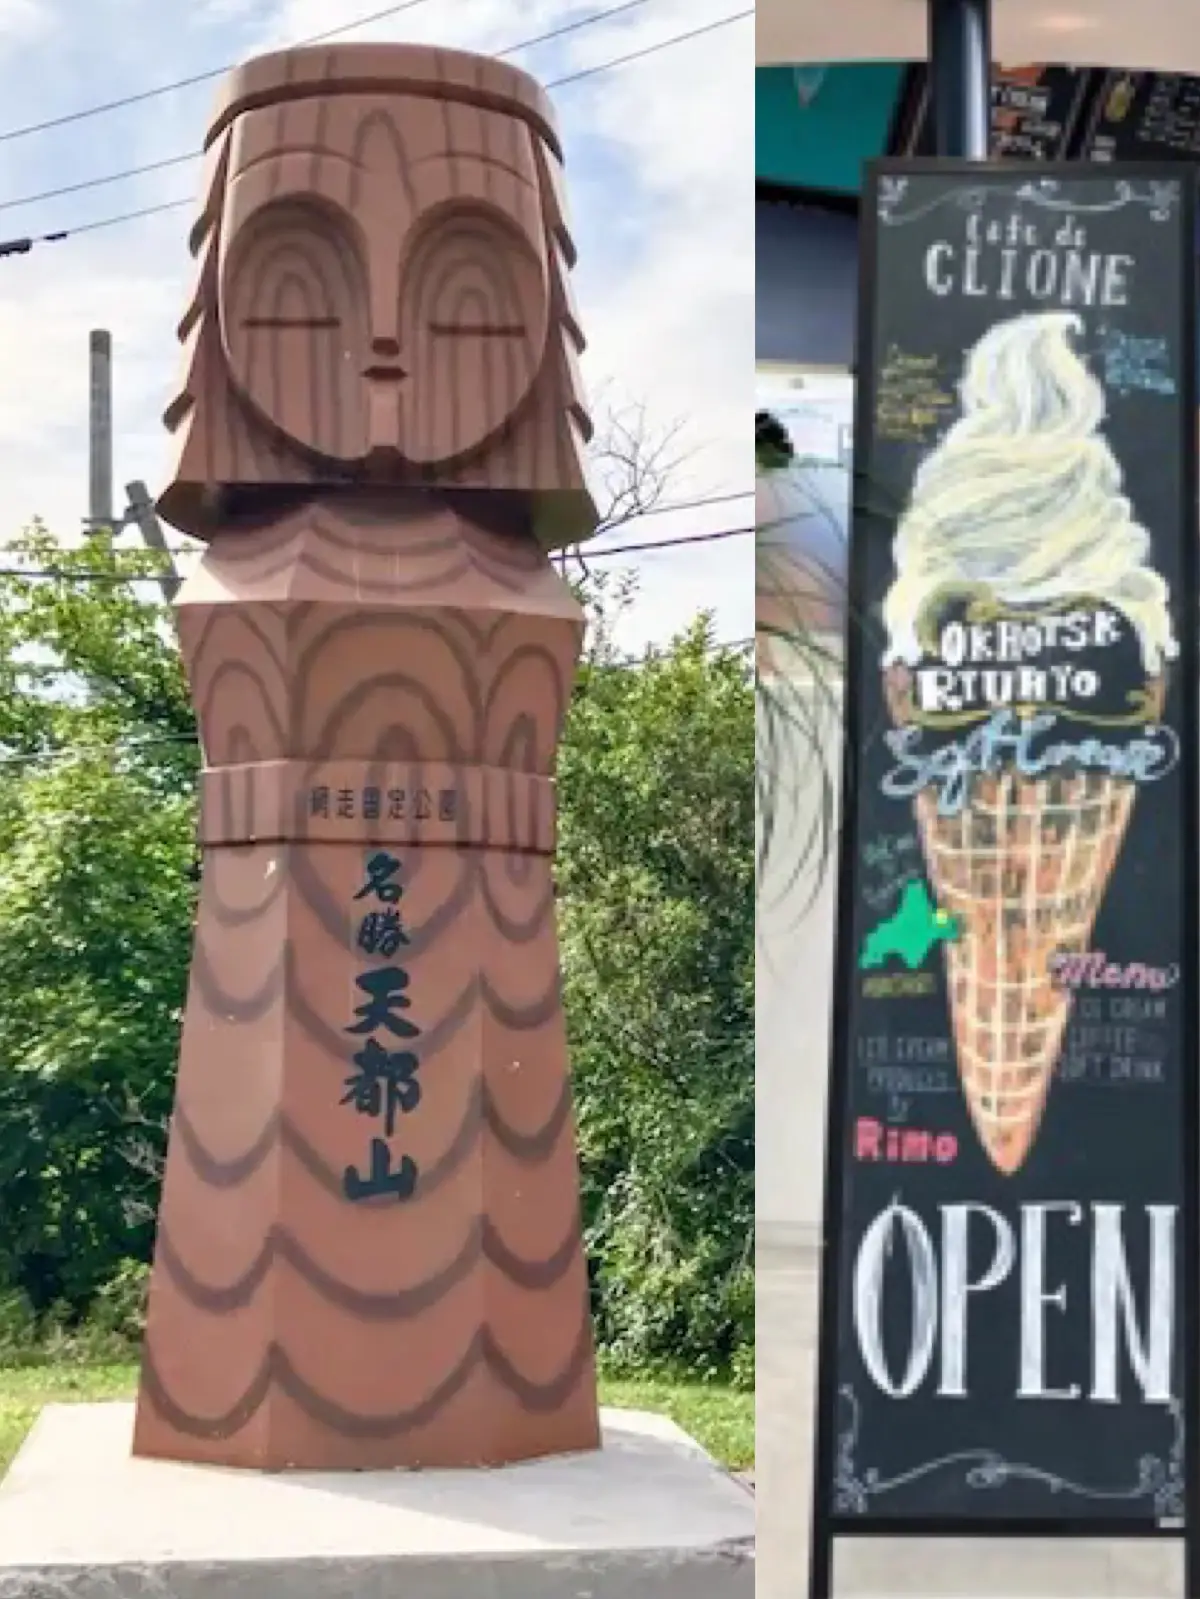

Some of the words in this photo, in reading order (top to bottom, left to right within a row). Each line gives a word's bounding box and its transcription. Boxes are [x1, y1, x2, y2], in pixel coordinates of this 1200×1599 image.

[924, 240, 1135, 306] CLIONE
[941, 610, 1121, 667] OKHOTSK
[853, 1117, 958, 1162] Rimo
[853, 1194, 1180, 1404] OPEN
